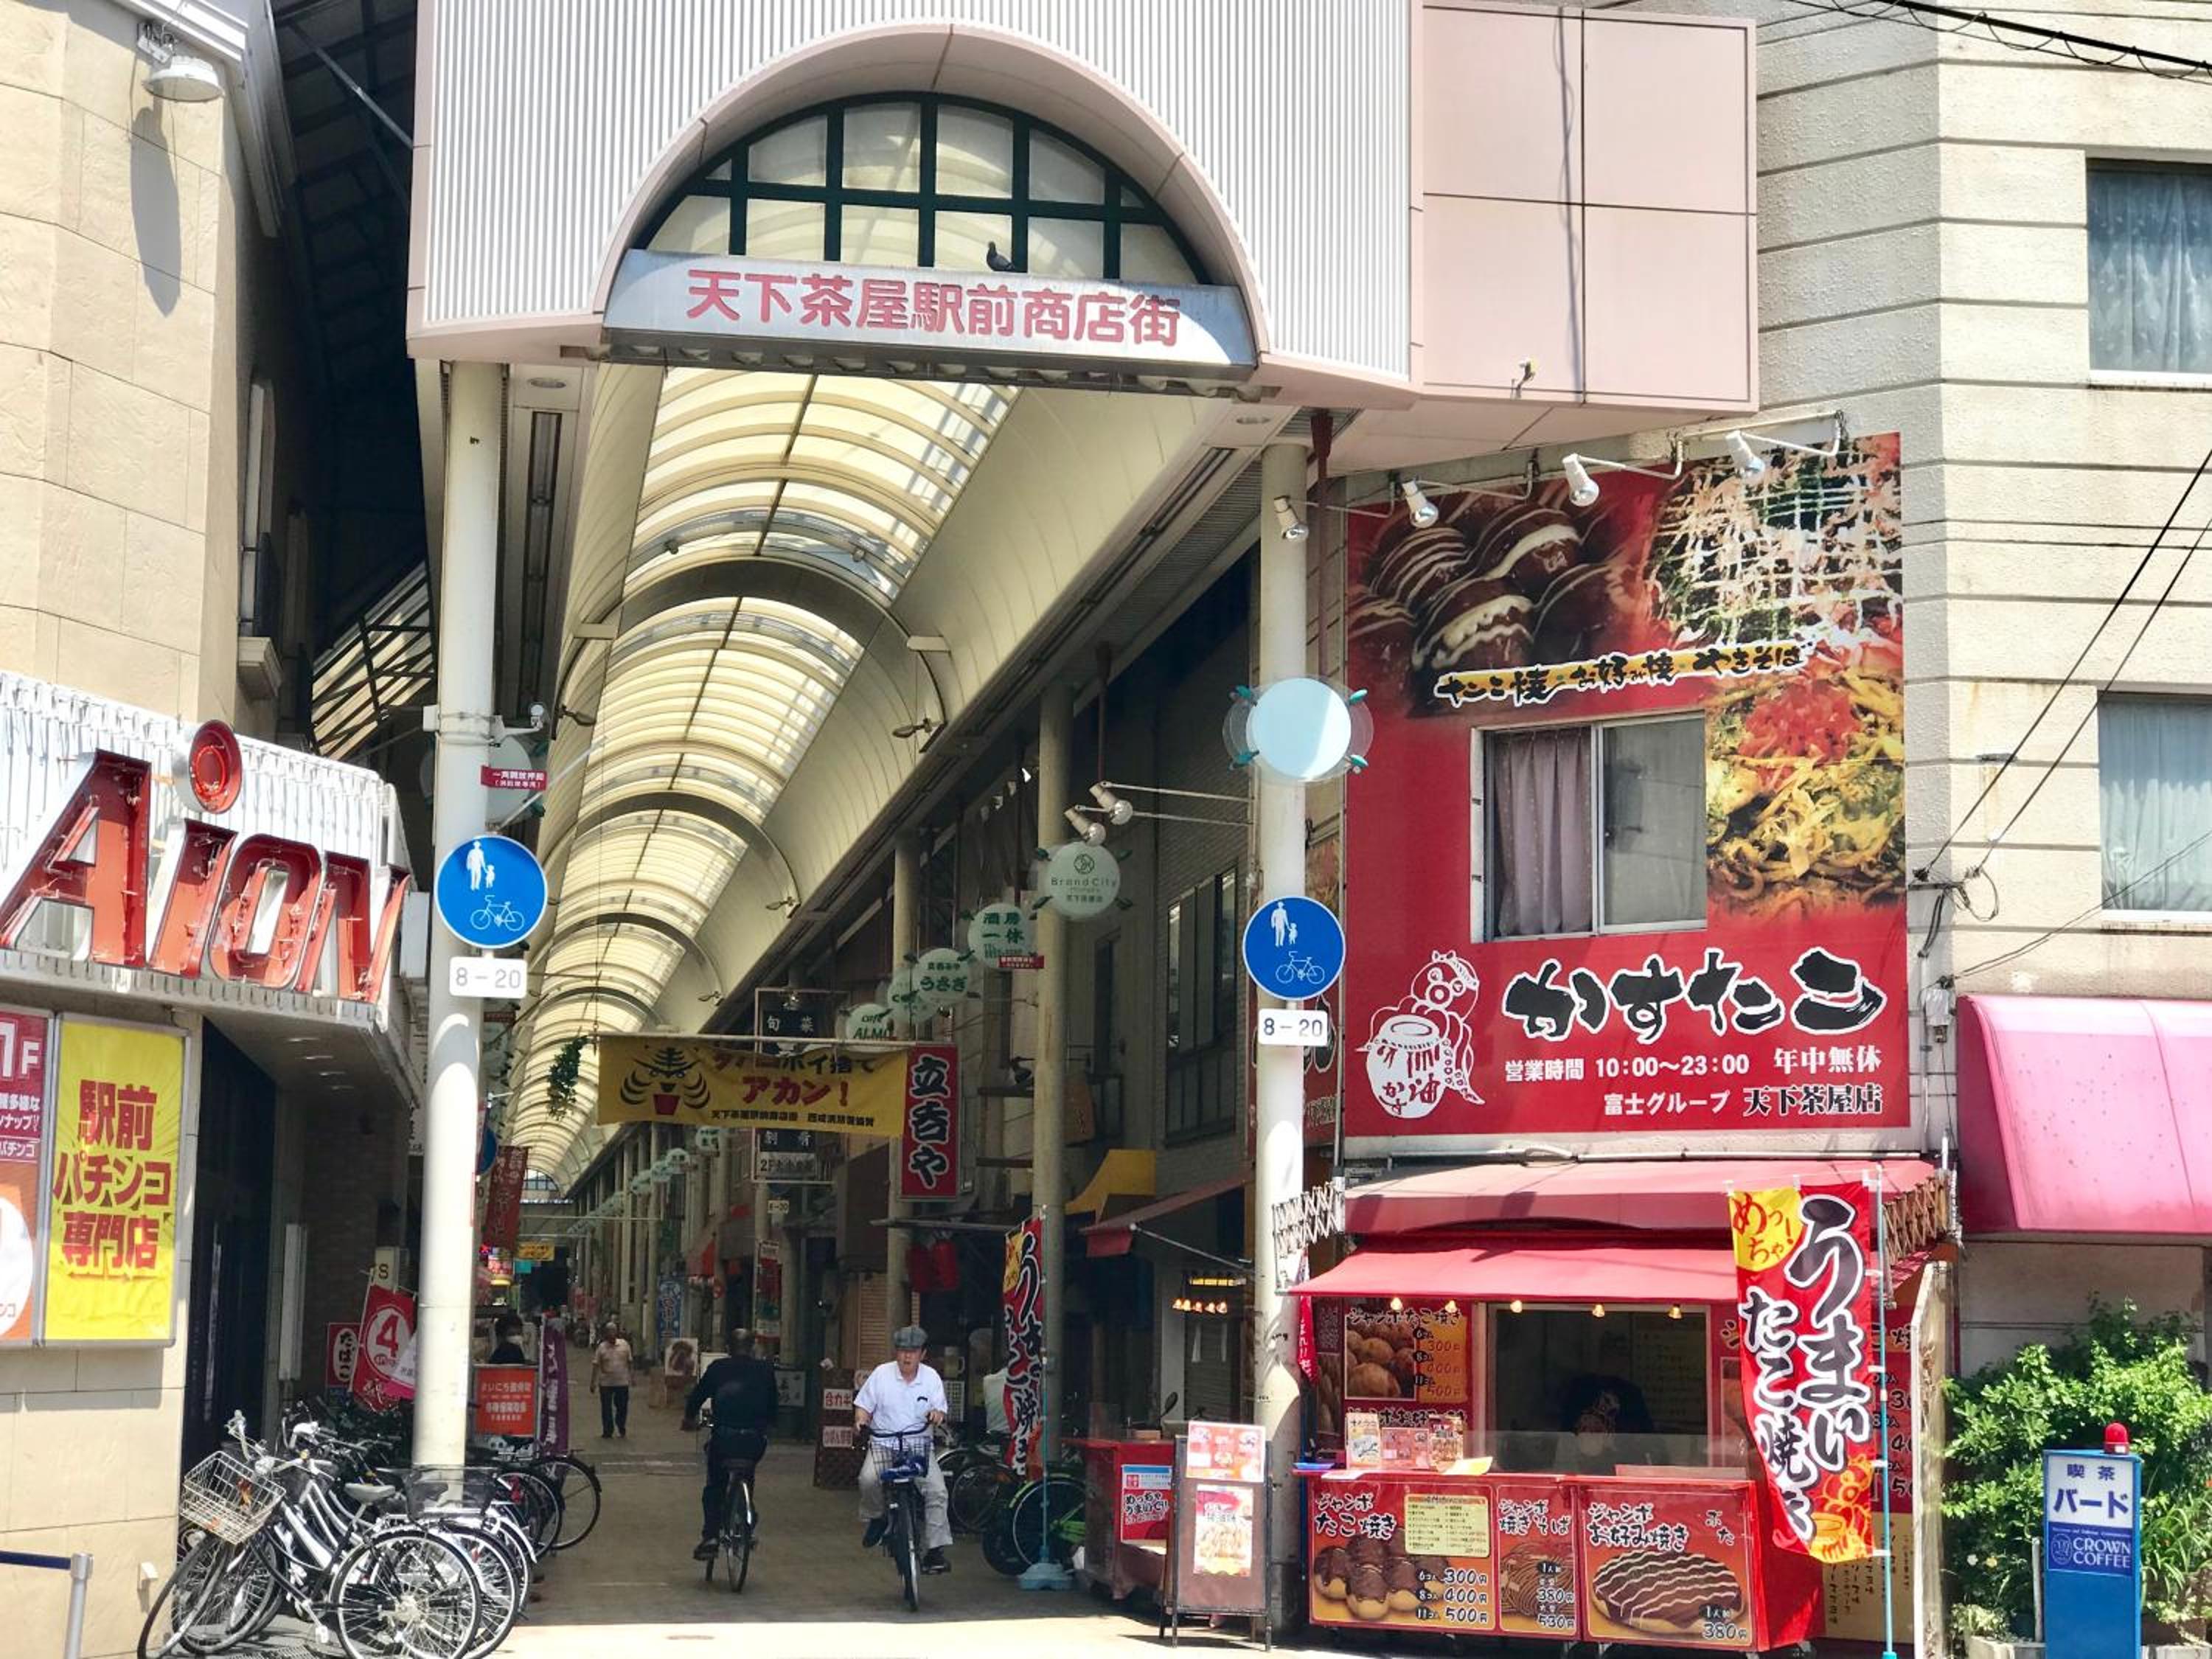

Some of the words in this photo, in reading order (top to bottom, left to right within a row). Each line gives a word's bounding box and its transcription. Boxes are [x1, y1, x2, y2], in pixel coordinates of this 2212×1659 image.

[686, 268, 1180, 347] 天下茶屋駅前商店街
[1051, 877, 1089, 886] Brand
[920, 976, 968, 992] うさぎ
[1501, 947, 1887, 1044] かすたこ
[1505, 1060, 1585, 1082] 営業時間
[1773, 1047, 1882, 1074] 年中無休
[1604, 1091, 1731, 1116] 富士グループ
[1743, 1086, 1883, 1118] 天下茶屋店
[77, 1079, 159, 1151] 駅前
[53, 1150, 173, 1208] パチンコ
[60, 1211, 161, 1274] 専門店
[375, 1313, 400, 1360] 4
[1784, 1194, 1871, 1472] うまい
[2067, 1464, 2115, 1481] 喫茶
[1317, 1492, 1374, 1512] ジャンボ
[1499, 1499, 1549, 1514] ジャンボ
[1589, 1503, 1654, 1523] ジャンボ
[2053, 1488, 2129, 1519] バード
[1315, 1512, 1397, 1540] たこ焼き
[1499, 1514, 1571, 1536] 焼きそば
[1587, 1523, 1689, 1552] お好み焼き
[2073, 1537, 2131, 1555] CROWN
[2073, 1551, 2131, 1568] COFFEE
[1443, 1568, 1488, 1585] 300円
[1443, 1588, 1488, 1604] 400円
[1538, 1589, 1575, 1604] 380円
[1444, 1607, 1488, 1623] 500円
[1703, 1624, 1747, 1640] 380円
